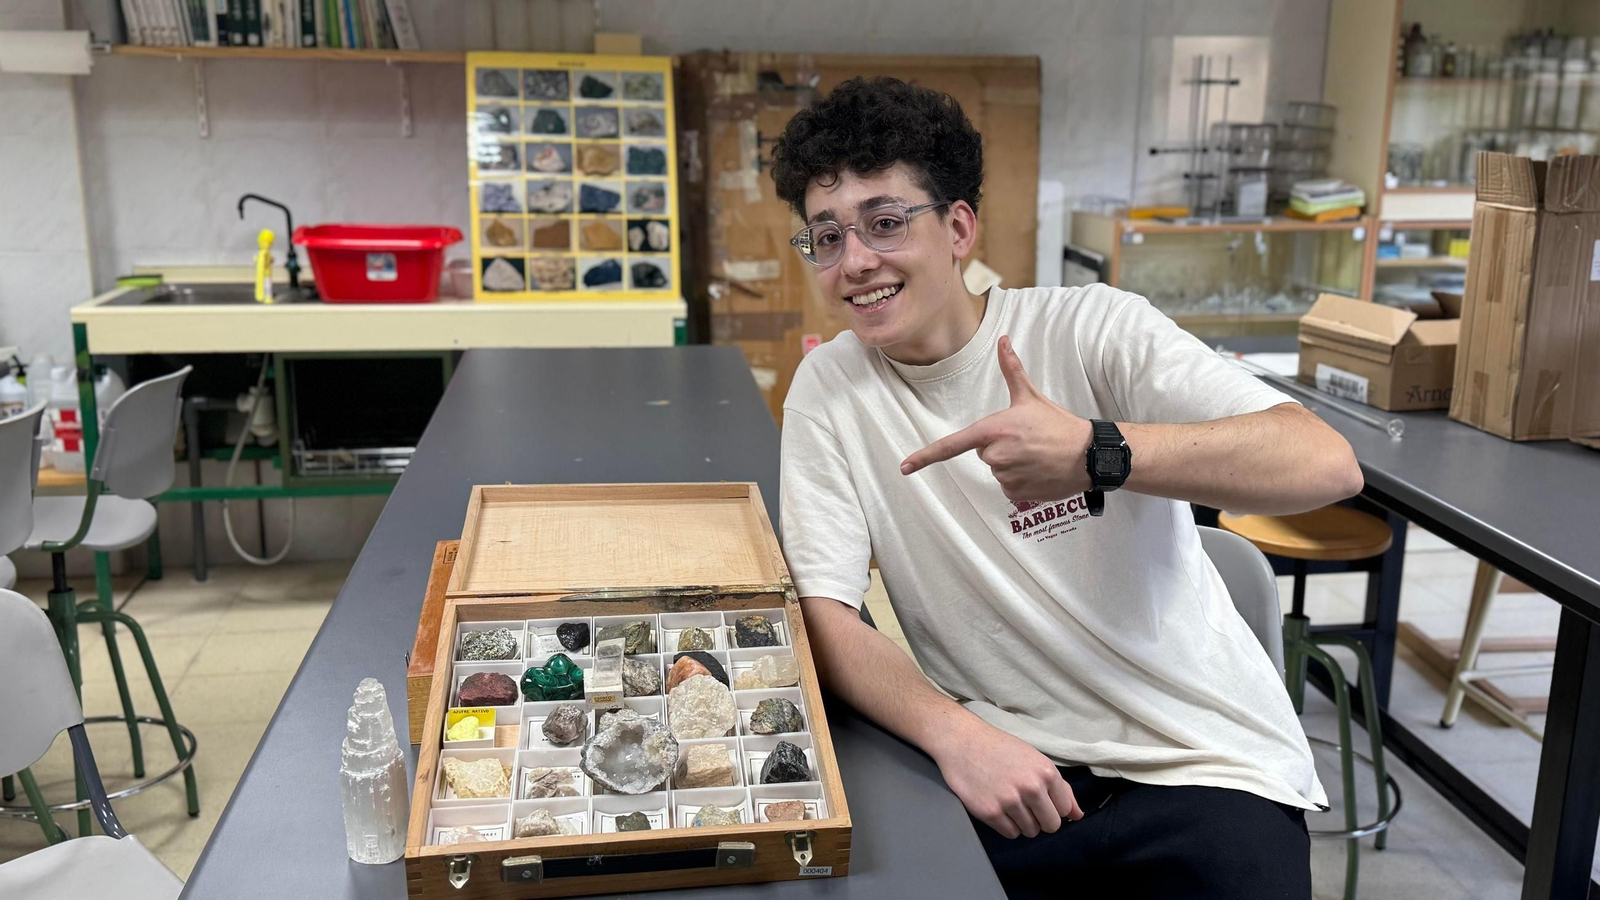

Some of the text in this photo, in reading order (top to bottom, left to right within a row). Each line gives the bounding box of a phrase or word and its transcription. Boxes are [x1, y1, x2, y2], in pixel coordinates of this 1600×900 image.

[1022, 530, 1033, 540] The
[1033, 525, 1048, 536] most
[1049, 519, 1071, 533] famous
[1060, 527, 1077, 535] Nevada
[802, 867, 829, 875] 000404
